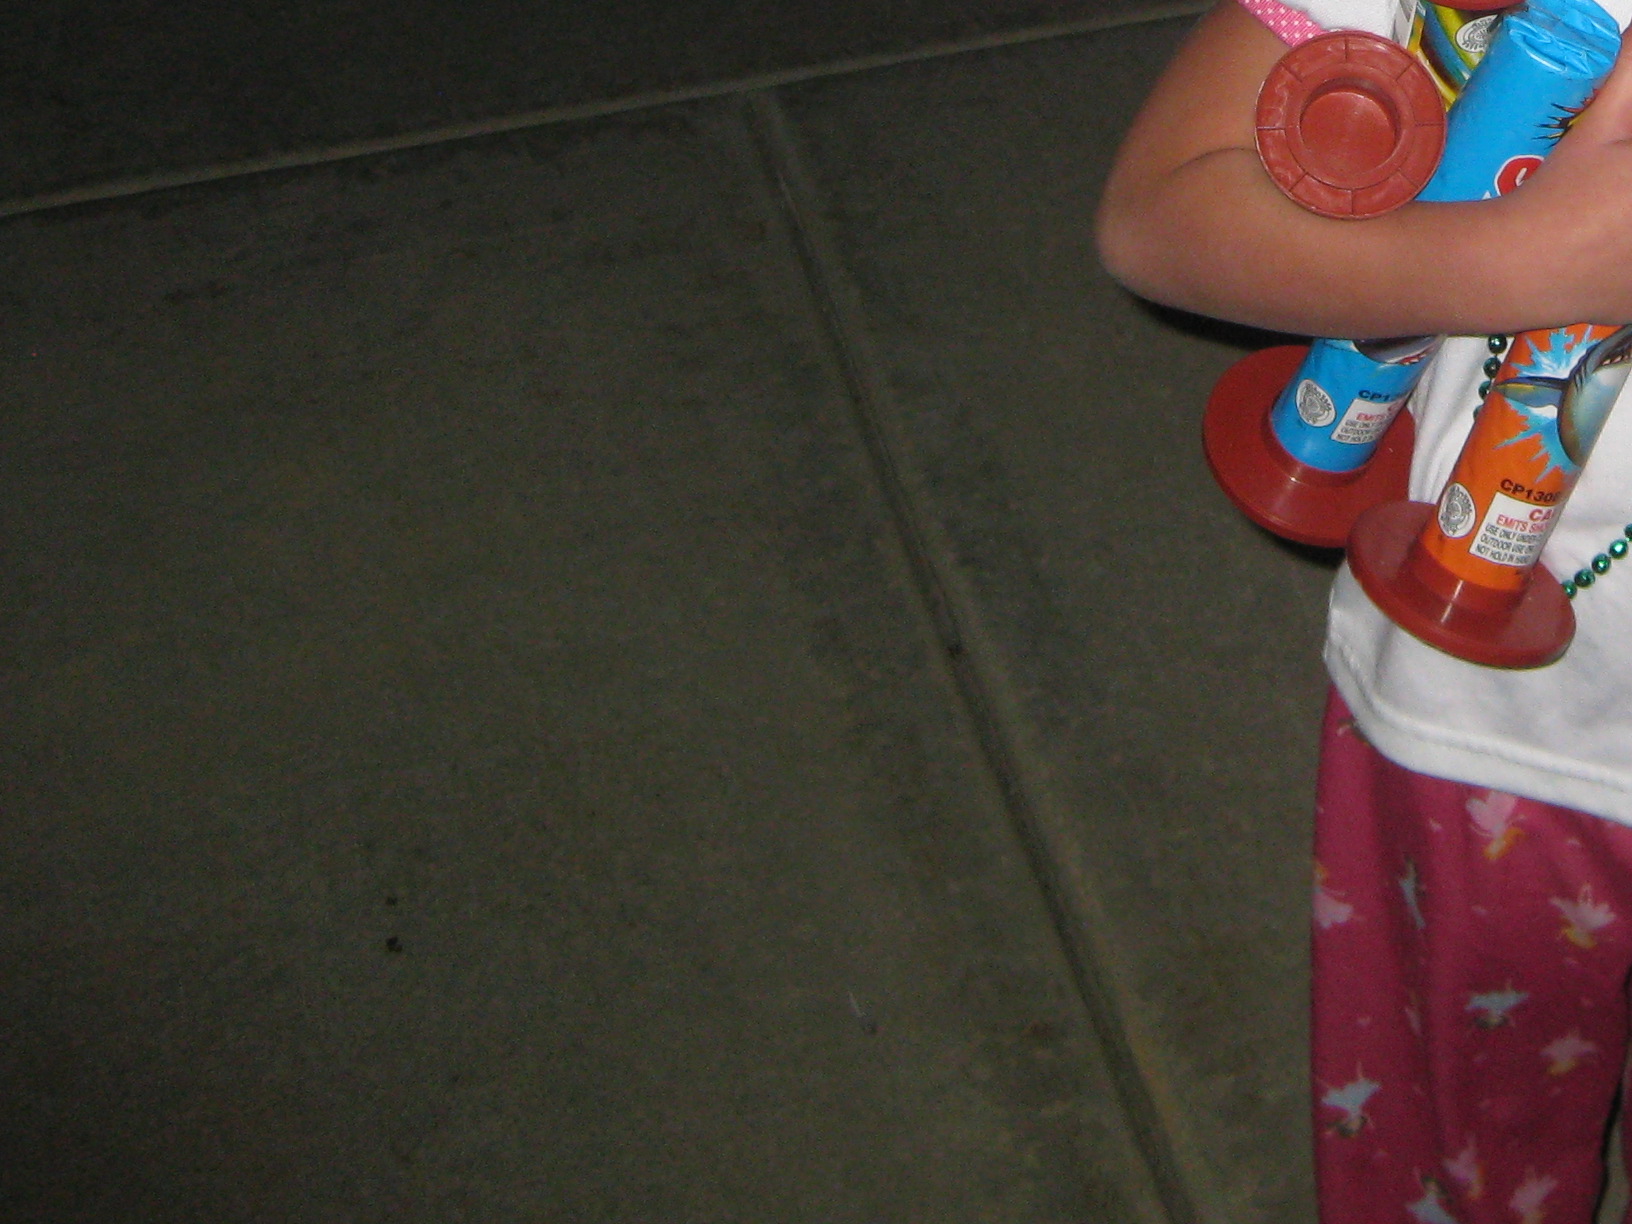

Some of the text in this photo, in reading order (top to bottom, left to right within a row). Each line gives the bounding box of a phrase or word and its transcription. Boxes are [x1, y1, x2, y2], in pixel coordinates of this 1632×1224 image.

[1485, 522, 1499, 536] USE
[1496, 514, 1528, 532] EMITS
[1480, 533, 1512, 552] OUTDOOR
[1475, 543, 1491, 556] NOT
[1490, 549, 1508, 562] HOLD
